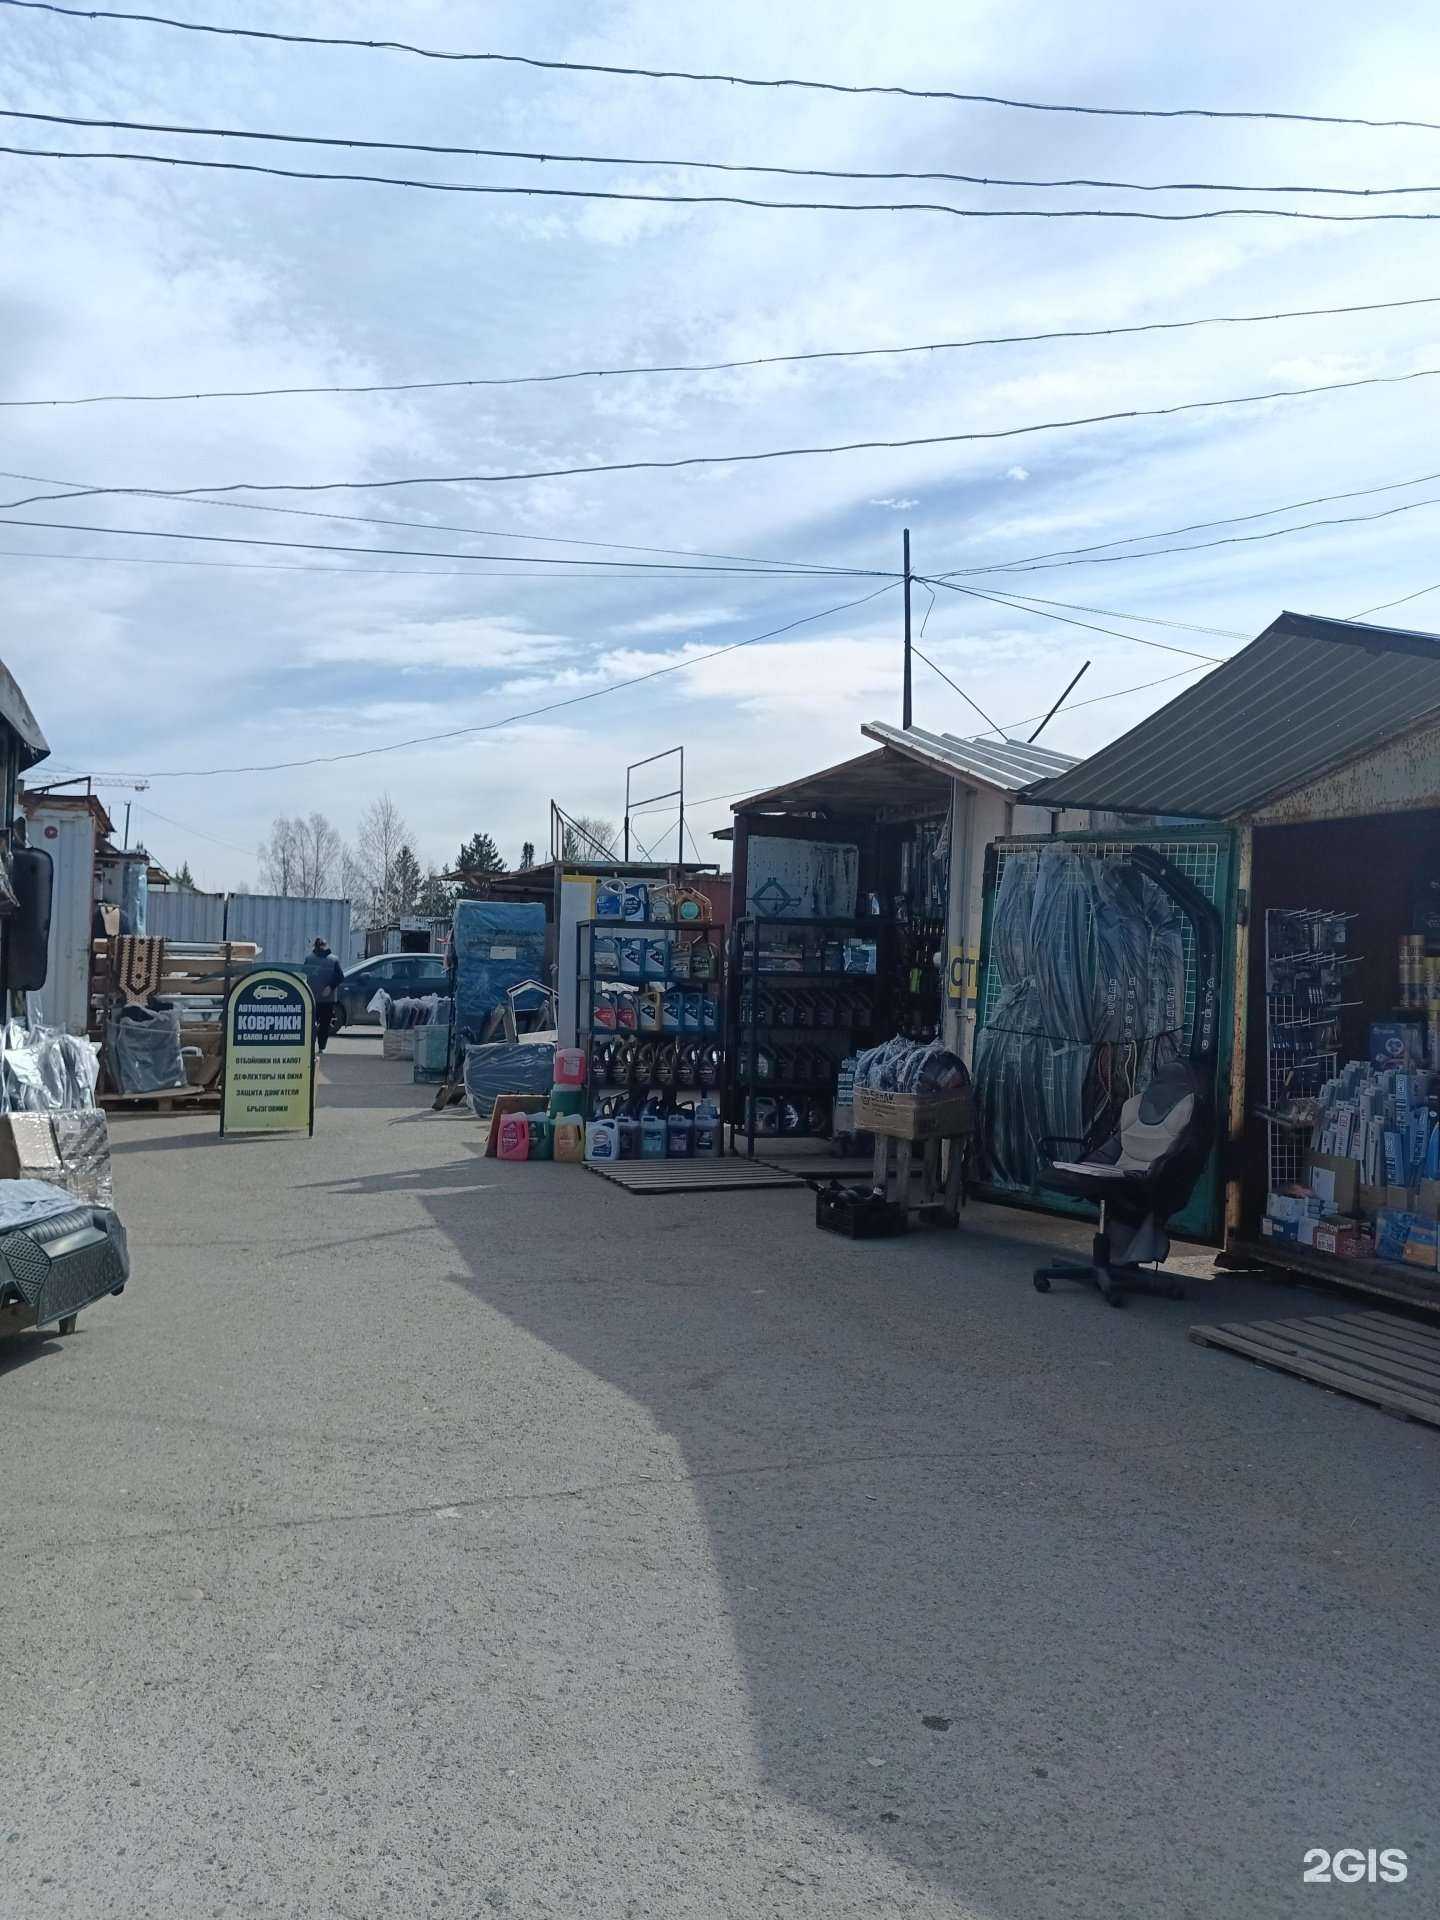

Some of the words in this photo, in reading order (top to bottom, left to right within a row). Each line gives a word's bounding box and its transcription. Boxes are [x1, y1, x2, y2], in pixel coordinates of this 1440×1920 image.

[238, 1004, 302, 1013] АВТОМОБИЛЬНЫЕ
[238, 1015, 302, 1030] КОВРИКИ
[233, 1073, 276, 1081] ДЕФЛЕКТОРЫ
[236, 1089, 263, 1097] ЗАЩИТА
